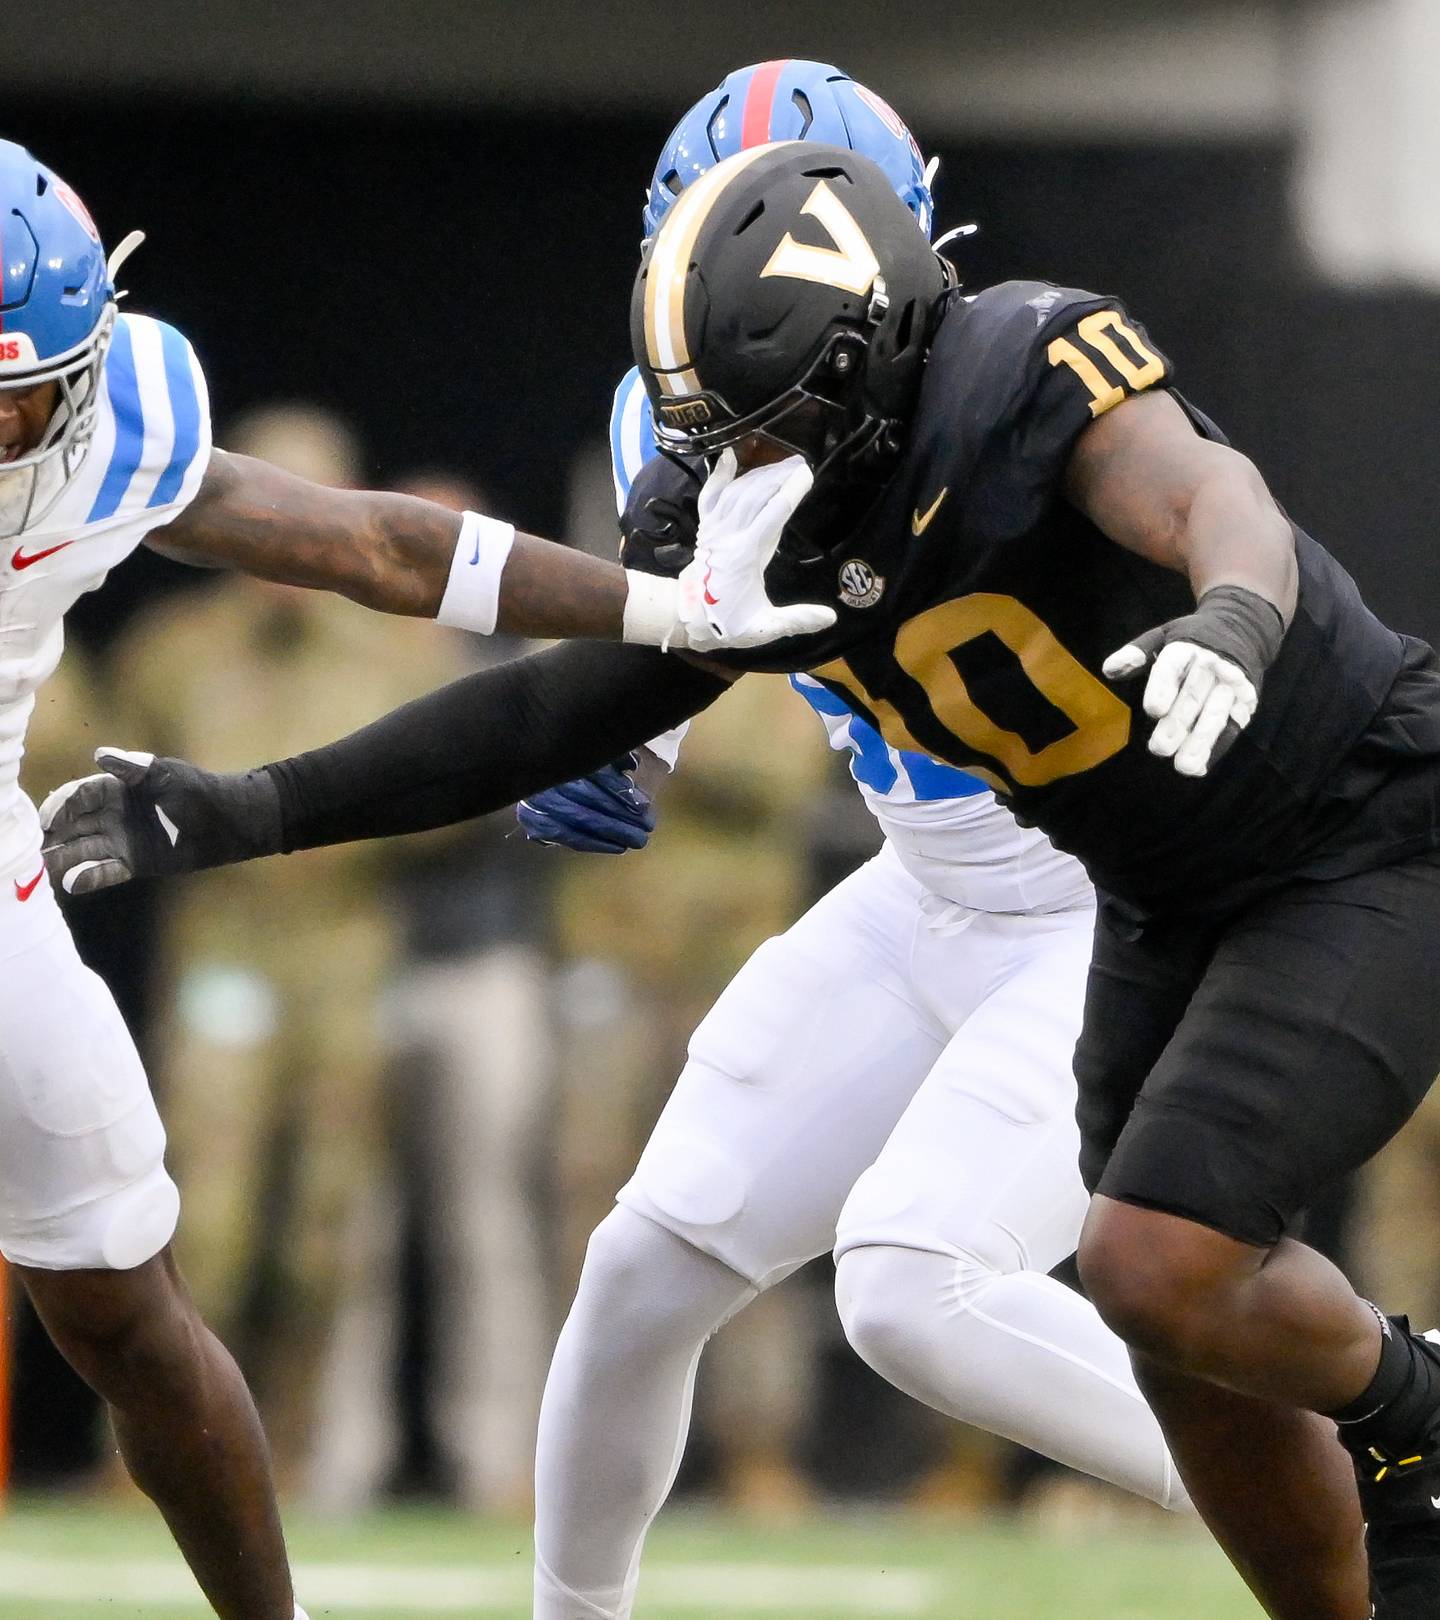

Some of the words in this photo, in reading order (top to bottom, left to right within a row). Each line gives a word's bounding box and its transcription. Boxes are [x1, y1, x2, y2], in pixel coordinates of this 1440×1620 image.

[760, 180, 880, 297] V
[1047, 311, 1164, 418] 10
[841, 562, 873, 595] SEC
